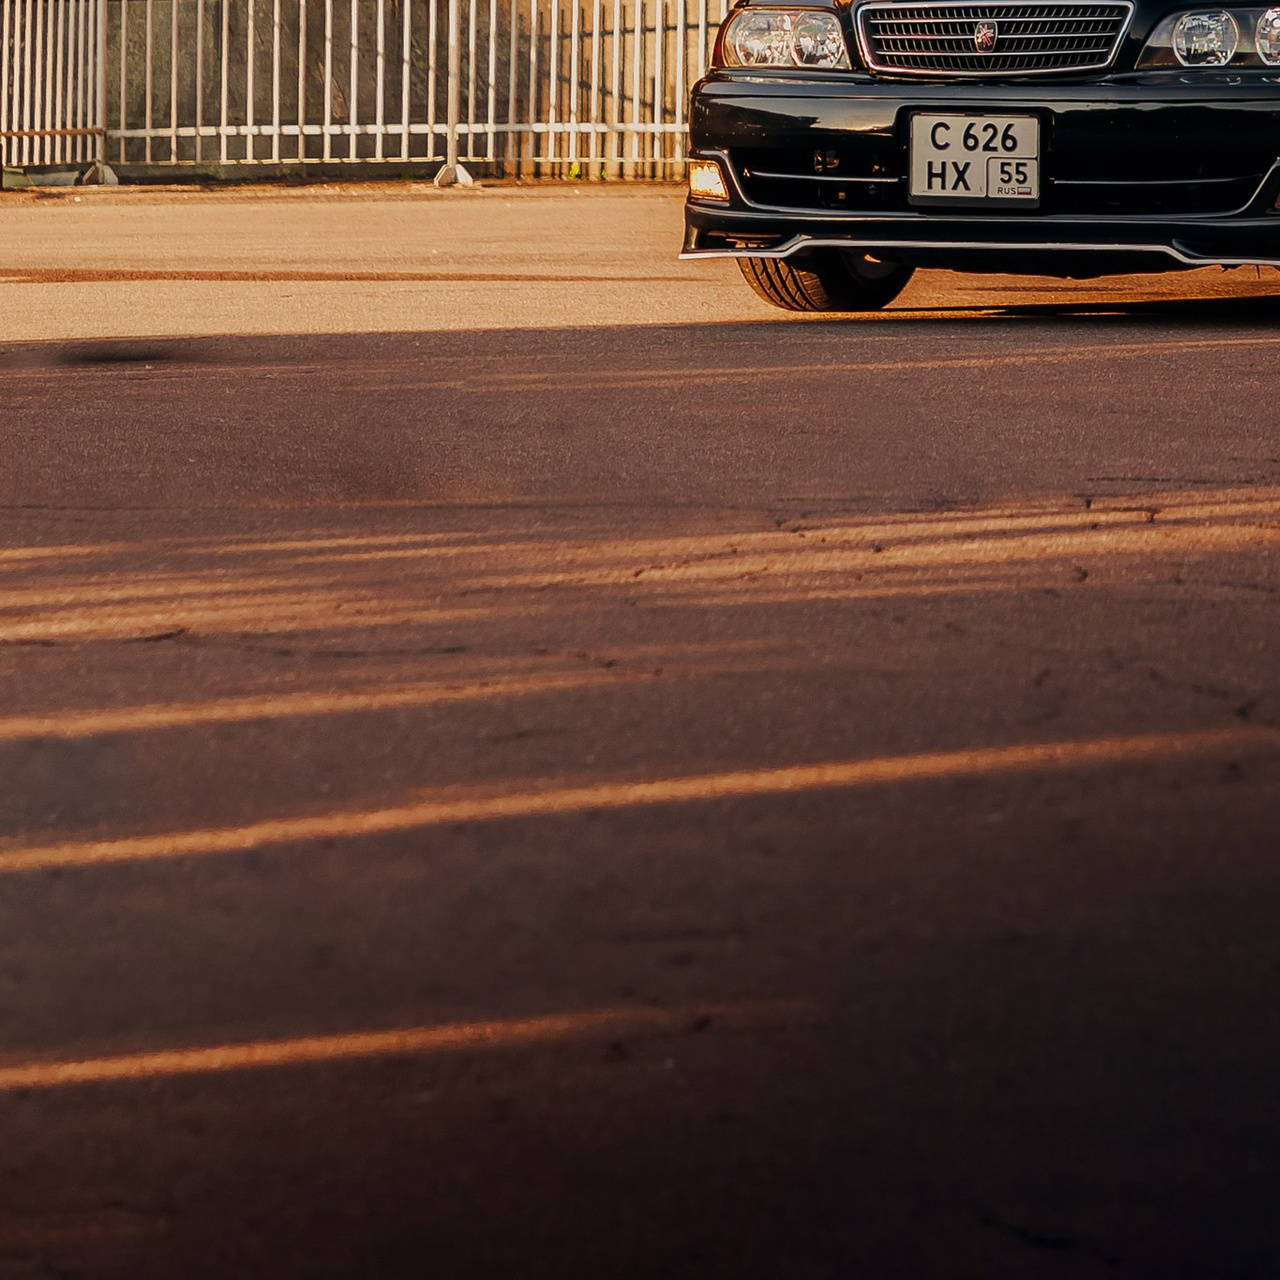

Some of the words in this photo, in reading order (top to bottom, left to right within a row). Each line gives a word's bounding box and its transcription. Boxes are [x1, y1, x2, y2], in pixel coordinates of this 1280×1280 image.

[930, 122, 951, 151] C
[962, 122, 1018, 152] 626
[927, 161, 971, 191] HX
[1000, 162, 1028, 184] 55
[997, 186, 1017, 195] RUS
